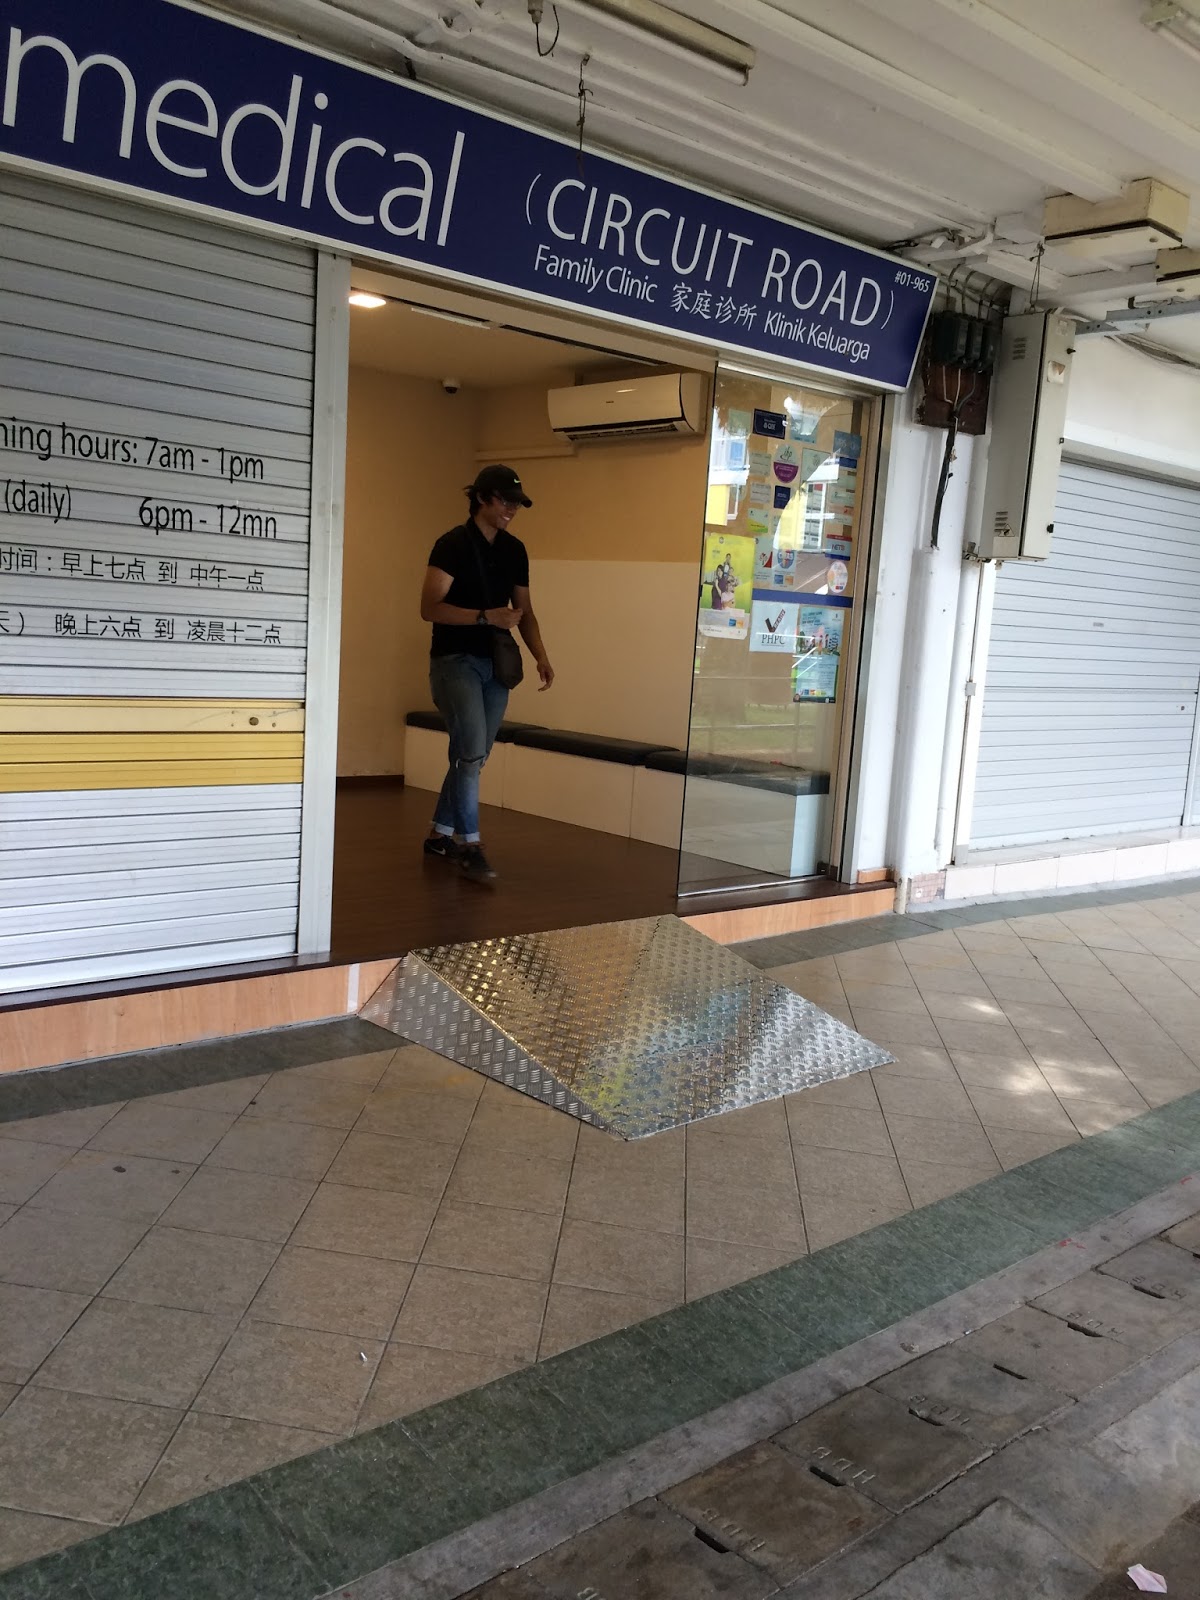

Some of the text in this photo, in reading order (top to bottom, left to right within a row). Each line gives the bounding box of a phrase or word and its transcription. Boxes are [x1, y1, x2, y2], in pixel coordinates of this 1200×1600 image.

[3, 27, 465, 246] medical
[534, 243, 871, 363] Family Clinic 家庭诊所 Klinik Keluarga
[894, 270, 931, 293] #01-965
[145, 436, 195, 471] 7am
[217, 448, 264, 483] 1pm
[5, 479, 72, 524] (daily)
[138, 497, 193, 535] 6pm
[217, 504, 277, 538] 12mn
[158, 561, 178, 584] 到
[190, 564, 265, 591] 中午一点
[55, 612, 142, 639] 晚上六点
[154, 618, 175, 640] 到
[187, 619, 282, 645] 凌晨十二点
